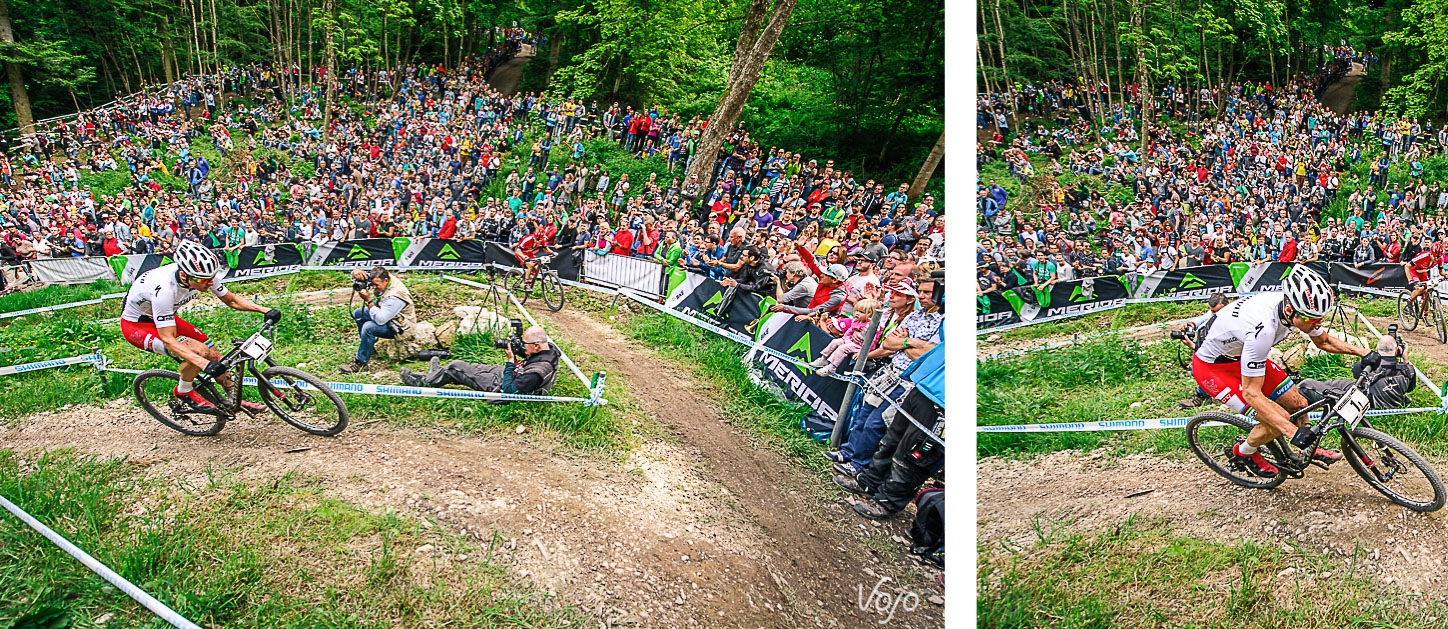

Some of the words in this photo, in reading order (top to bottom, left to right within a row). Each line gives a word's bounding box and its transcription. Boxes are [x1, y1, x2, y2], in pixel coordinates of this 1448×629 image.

[1047, 298, 1127, 317] MERIDA
[14, 359, 66, 372] SHIMANO
[376, 385, 422, 395] SHIMANO
[1160, 417, 1191, 427] SHIM
